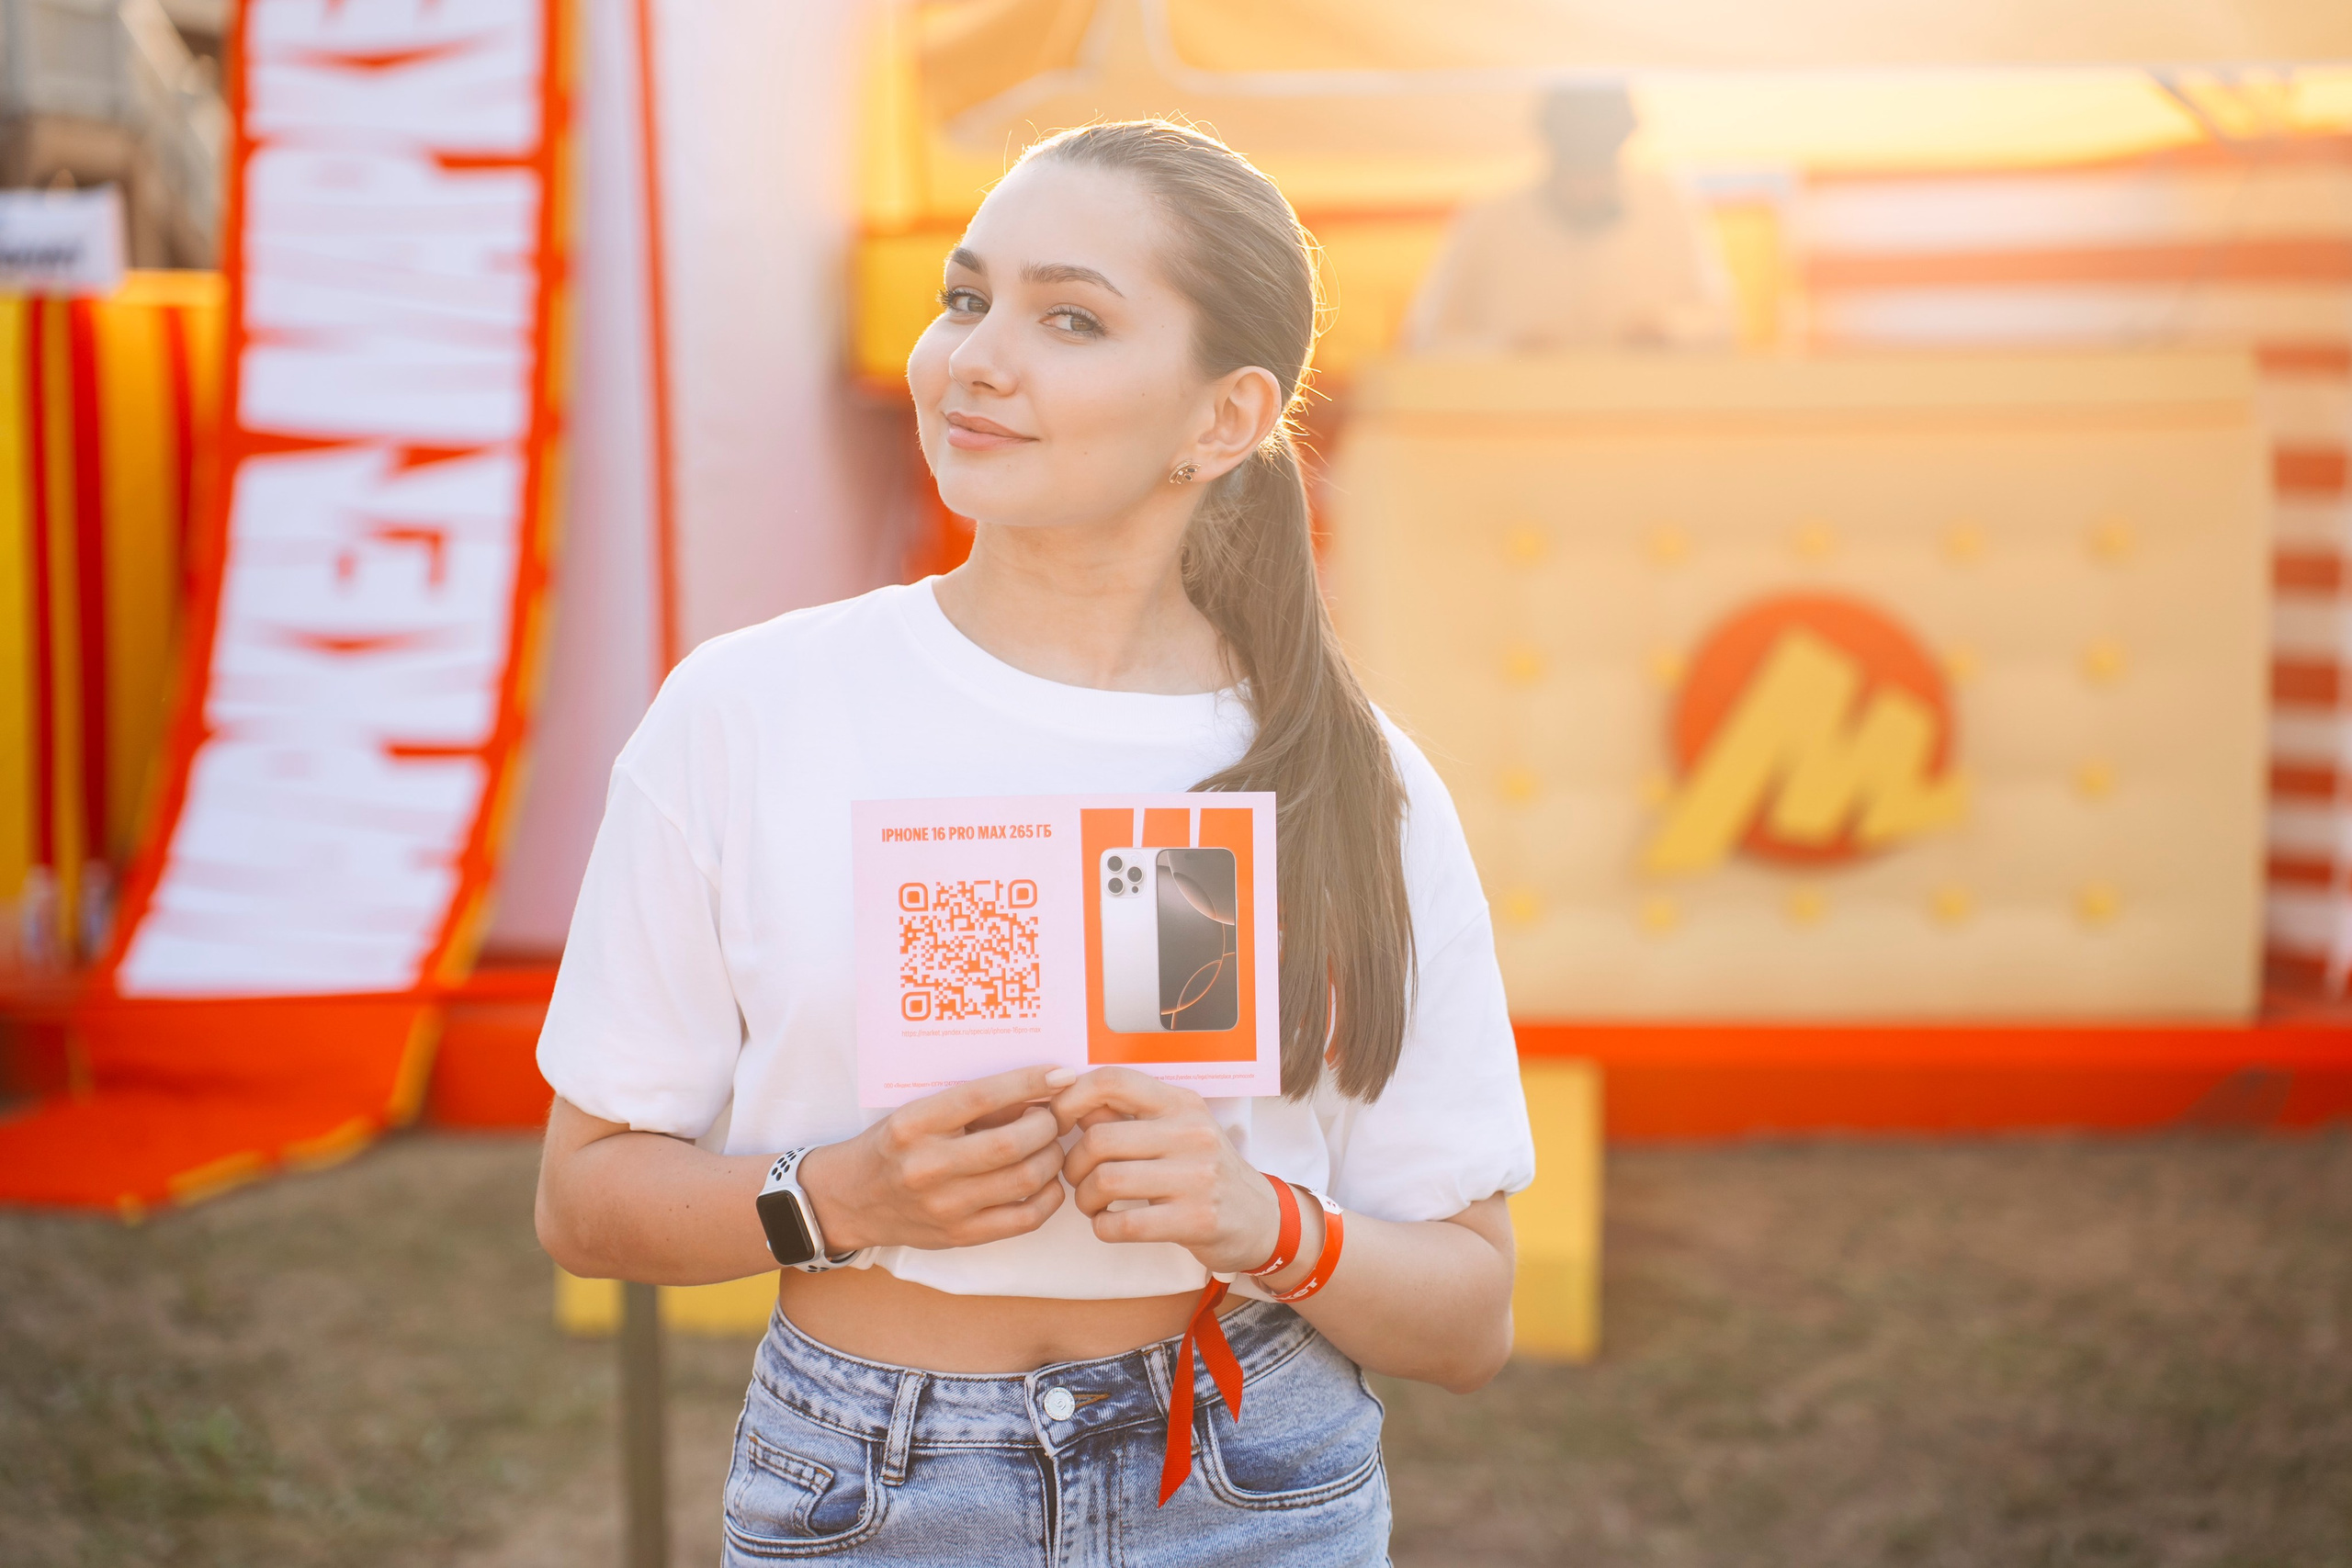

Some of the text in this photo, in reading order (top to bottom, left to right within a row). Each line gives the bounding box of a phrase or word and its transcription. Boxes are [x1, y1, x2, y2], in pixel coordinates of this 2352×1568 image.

[881, 823, 1052, 842] IPHONE 16 PRO MAX 265 ГБ
